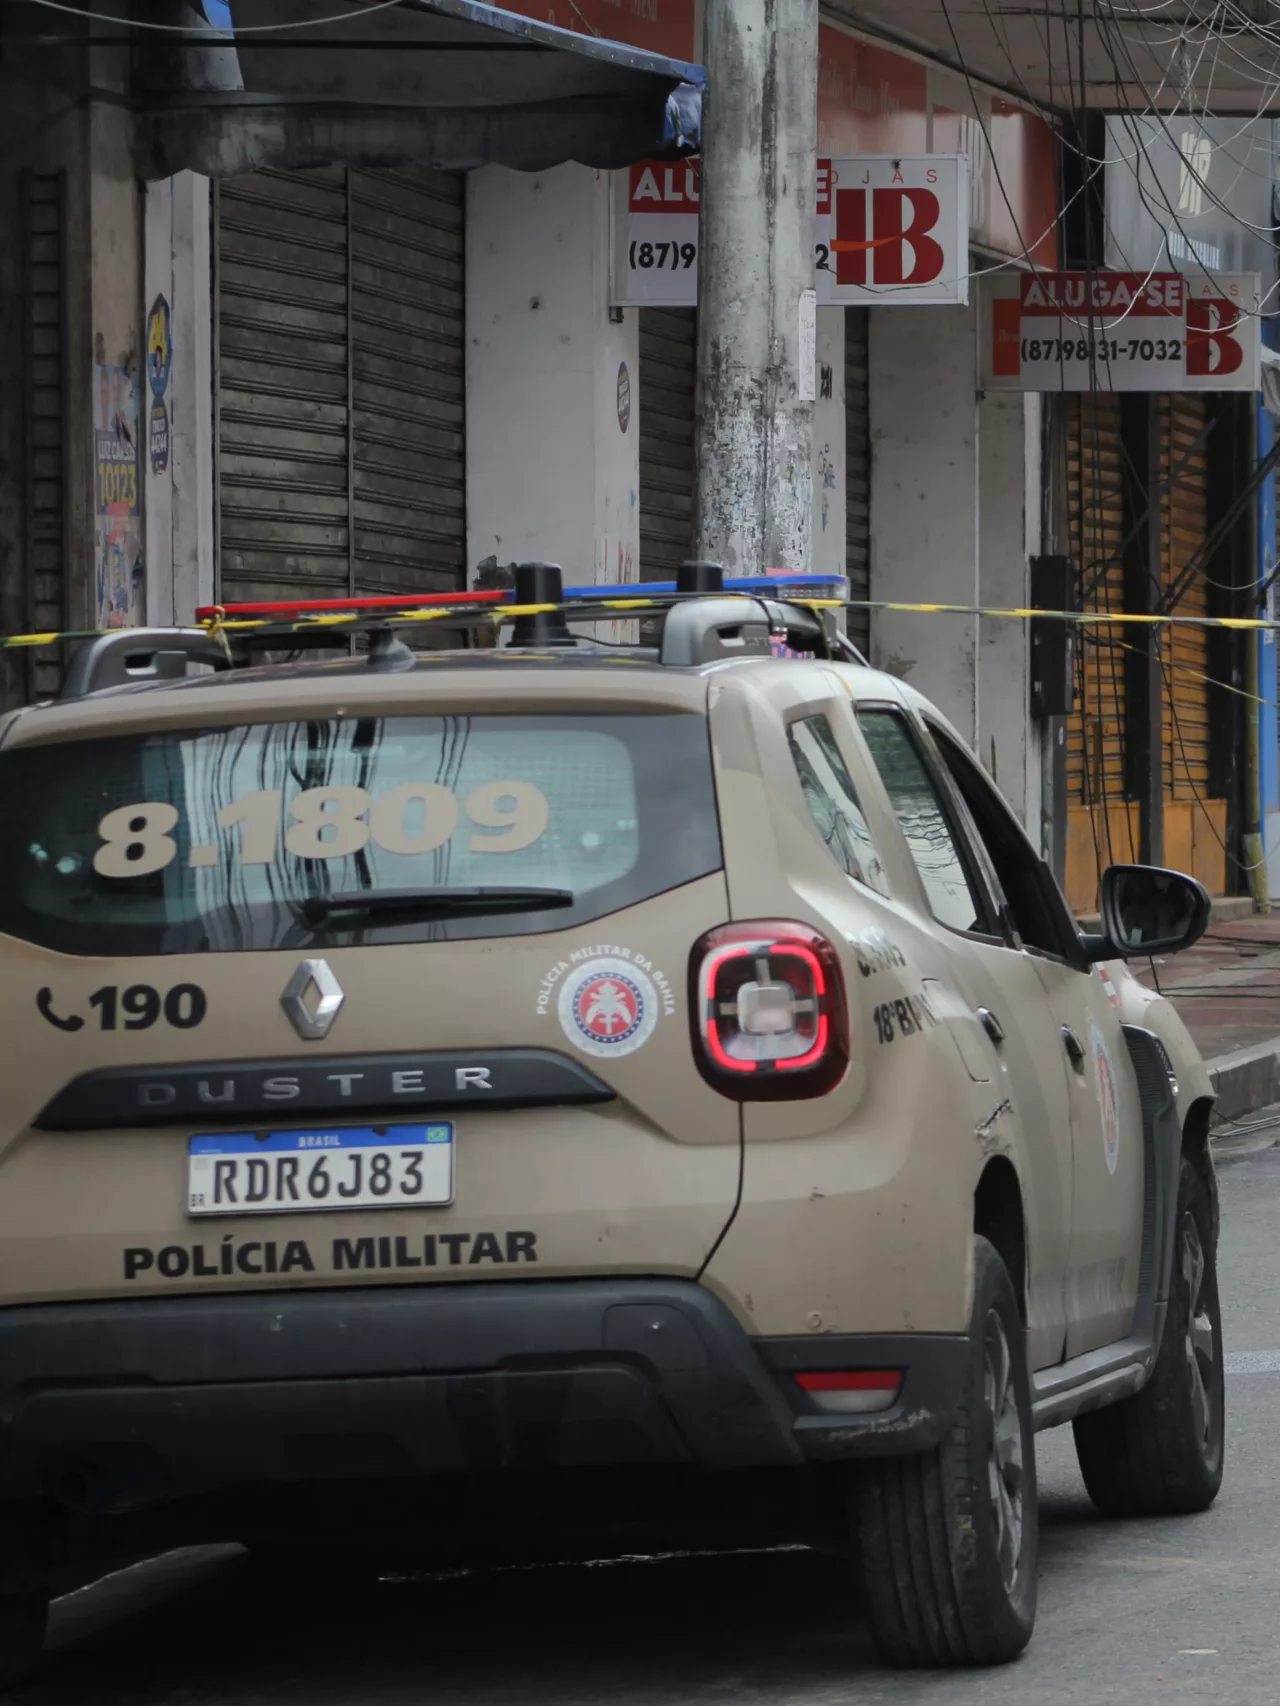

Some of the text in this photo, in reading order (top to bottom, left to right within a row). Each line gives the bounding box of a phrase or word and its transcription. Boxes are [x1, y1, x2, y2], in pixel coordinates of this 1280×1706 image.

[1022, 279, 1181, 308] ALUGA-SE
[93, 780, 549, 878] 8.1809
[535, 944, 676, 1016] POLÍCIA MILITAR DA BAHIA
[89, 983, 207, 1031] 190
[137, 1066, 493, 1107] DUSTER
[298, 1136, 341, 1148] BRASIL
[213, 1151, 424, 1204] RDR6J83
[123, 1231, 538, 1279] POLÍCIA MILITAR
